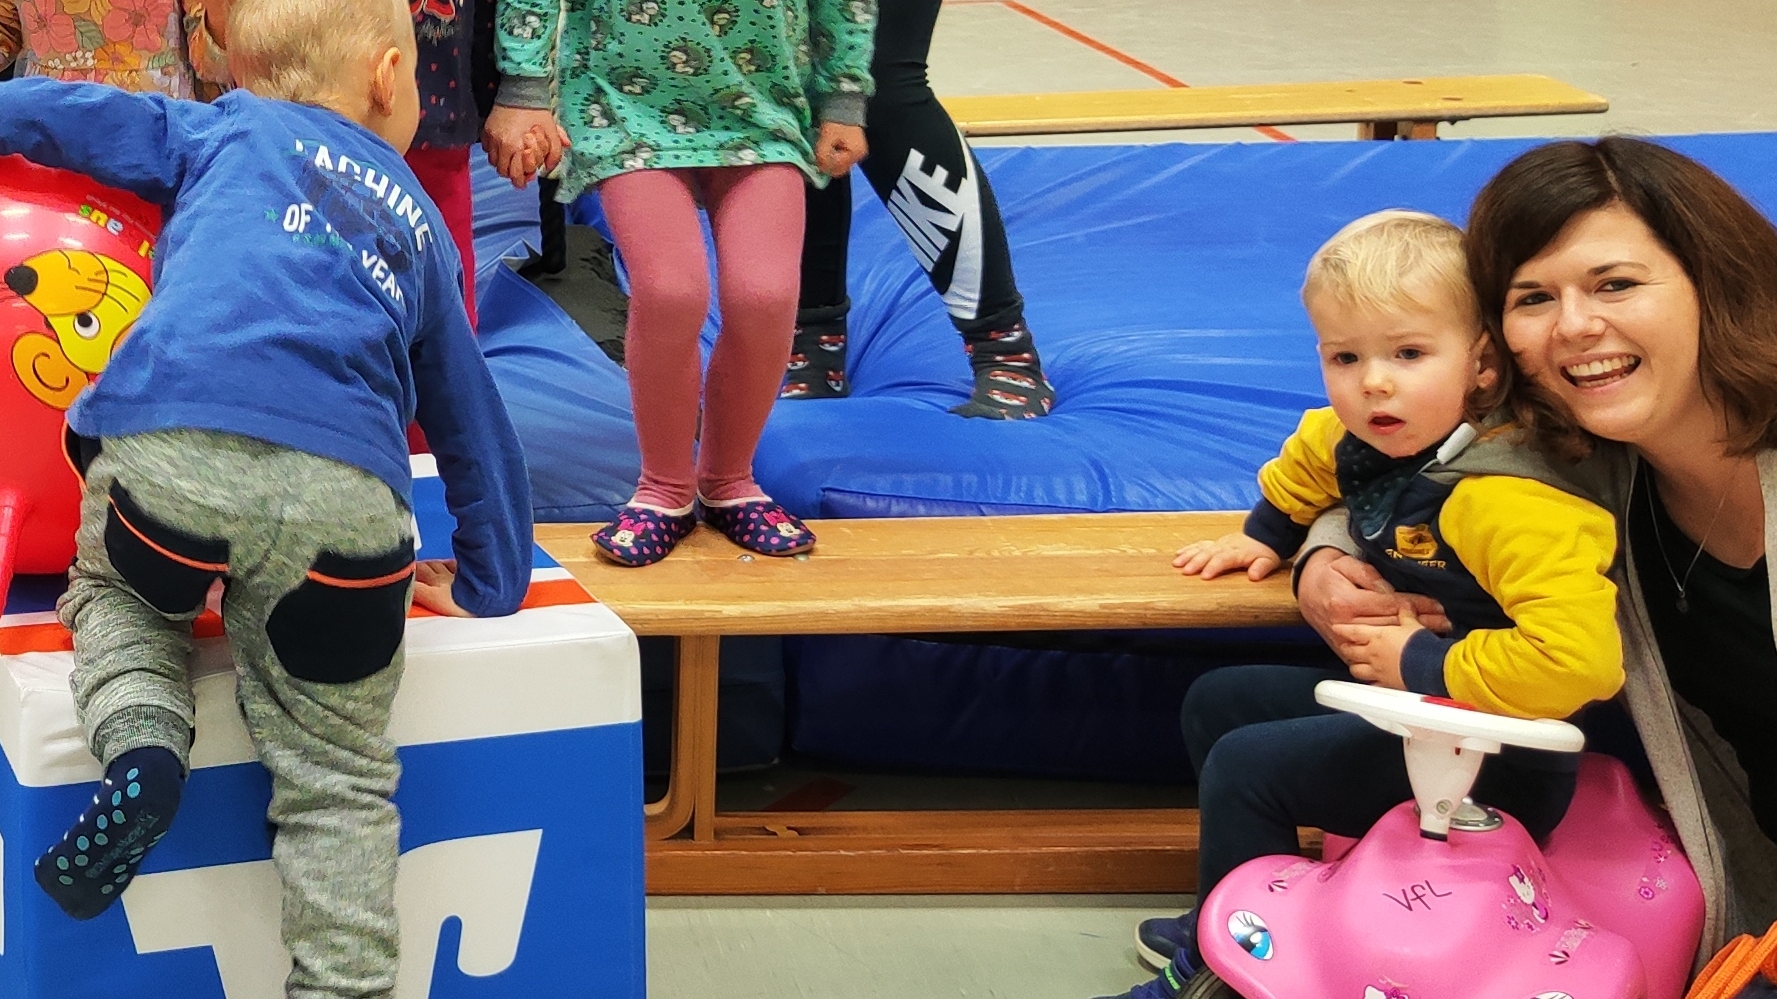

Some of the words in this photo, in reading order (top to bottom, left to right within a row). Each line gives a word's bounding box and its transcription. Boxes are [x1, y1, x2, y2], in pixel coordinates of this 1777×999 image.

[282, 202, 315, 234] OF
[294, 138, 434, 252] ACHINE
[887, 147, 967, 273] NIKE
